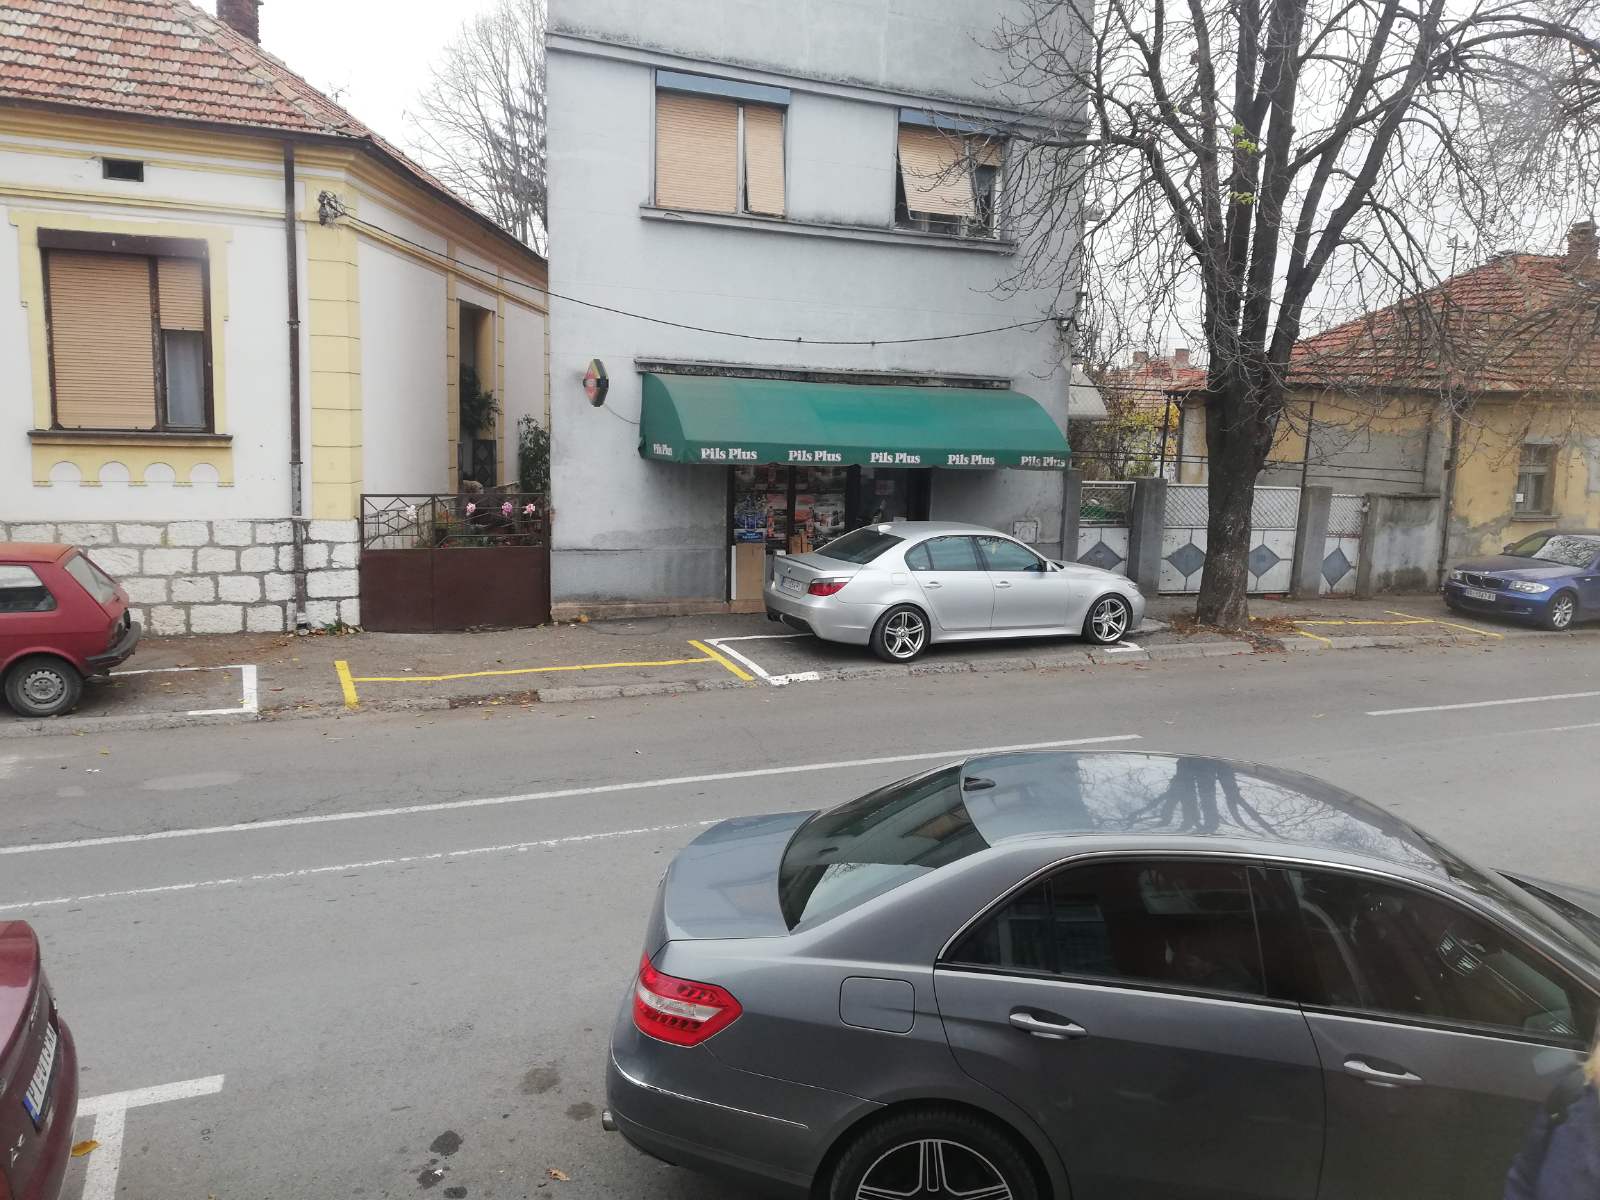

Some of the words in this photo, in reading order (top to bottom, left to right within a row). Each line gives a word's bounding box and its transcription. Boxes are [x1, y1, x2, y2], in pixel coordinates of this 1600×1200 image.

[701, 448, 726, 459] Pils
[728, 448, 757, 460] Plus
[788, 450, 812, 461] Pils
[814, 451, 841, 462] Plus
[870, 452, 893, 463] Pils
[895, 453, 920, 464] Plus
[947, 454, 968, 465] Pils
[970, 455, 995, 465] Plus
